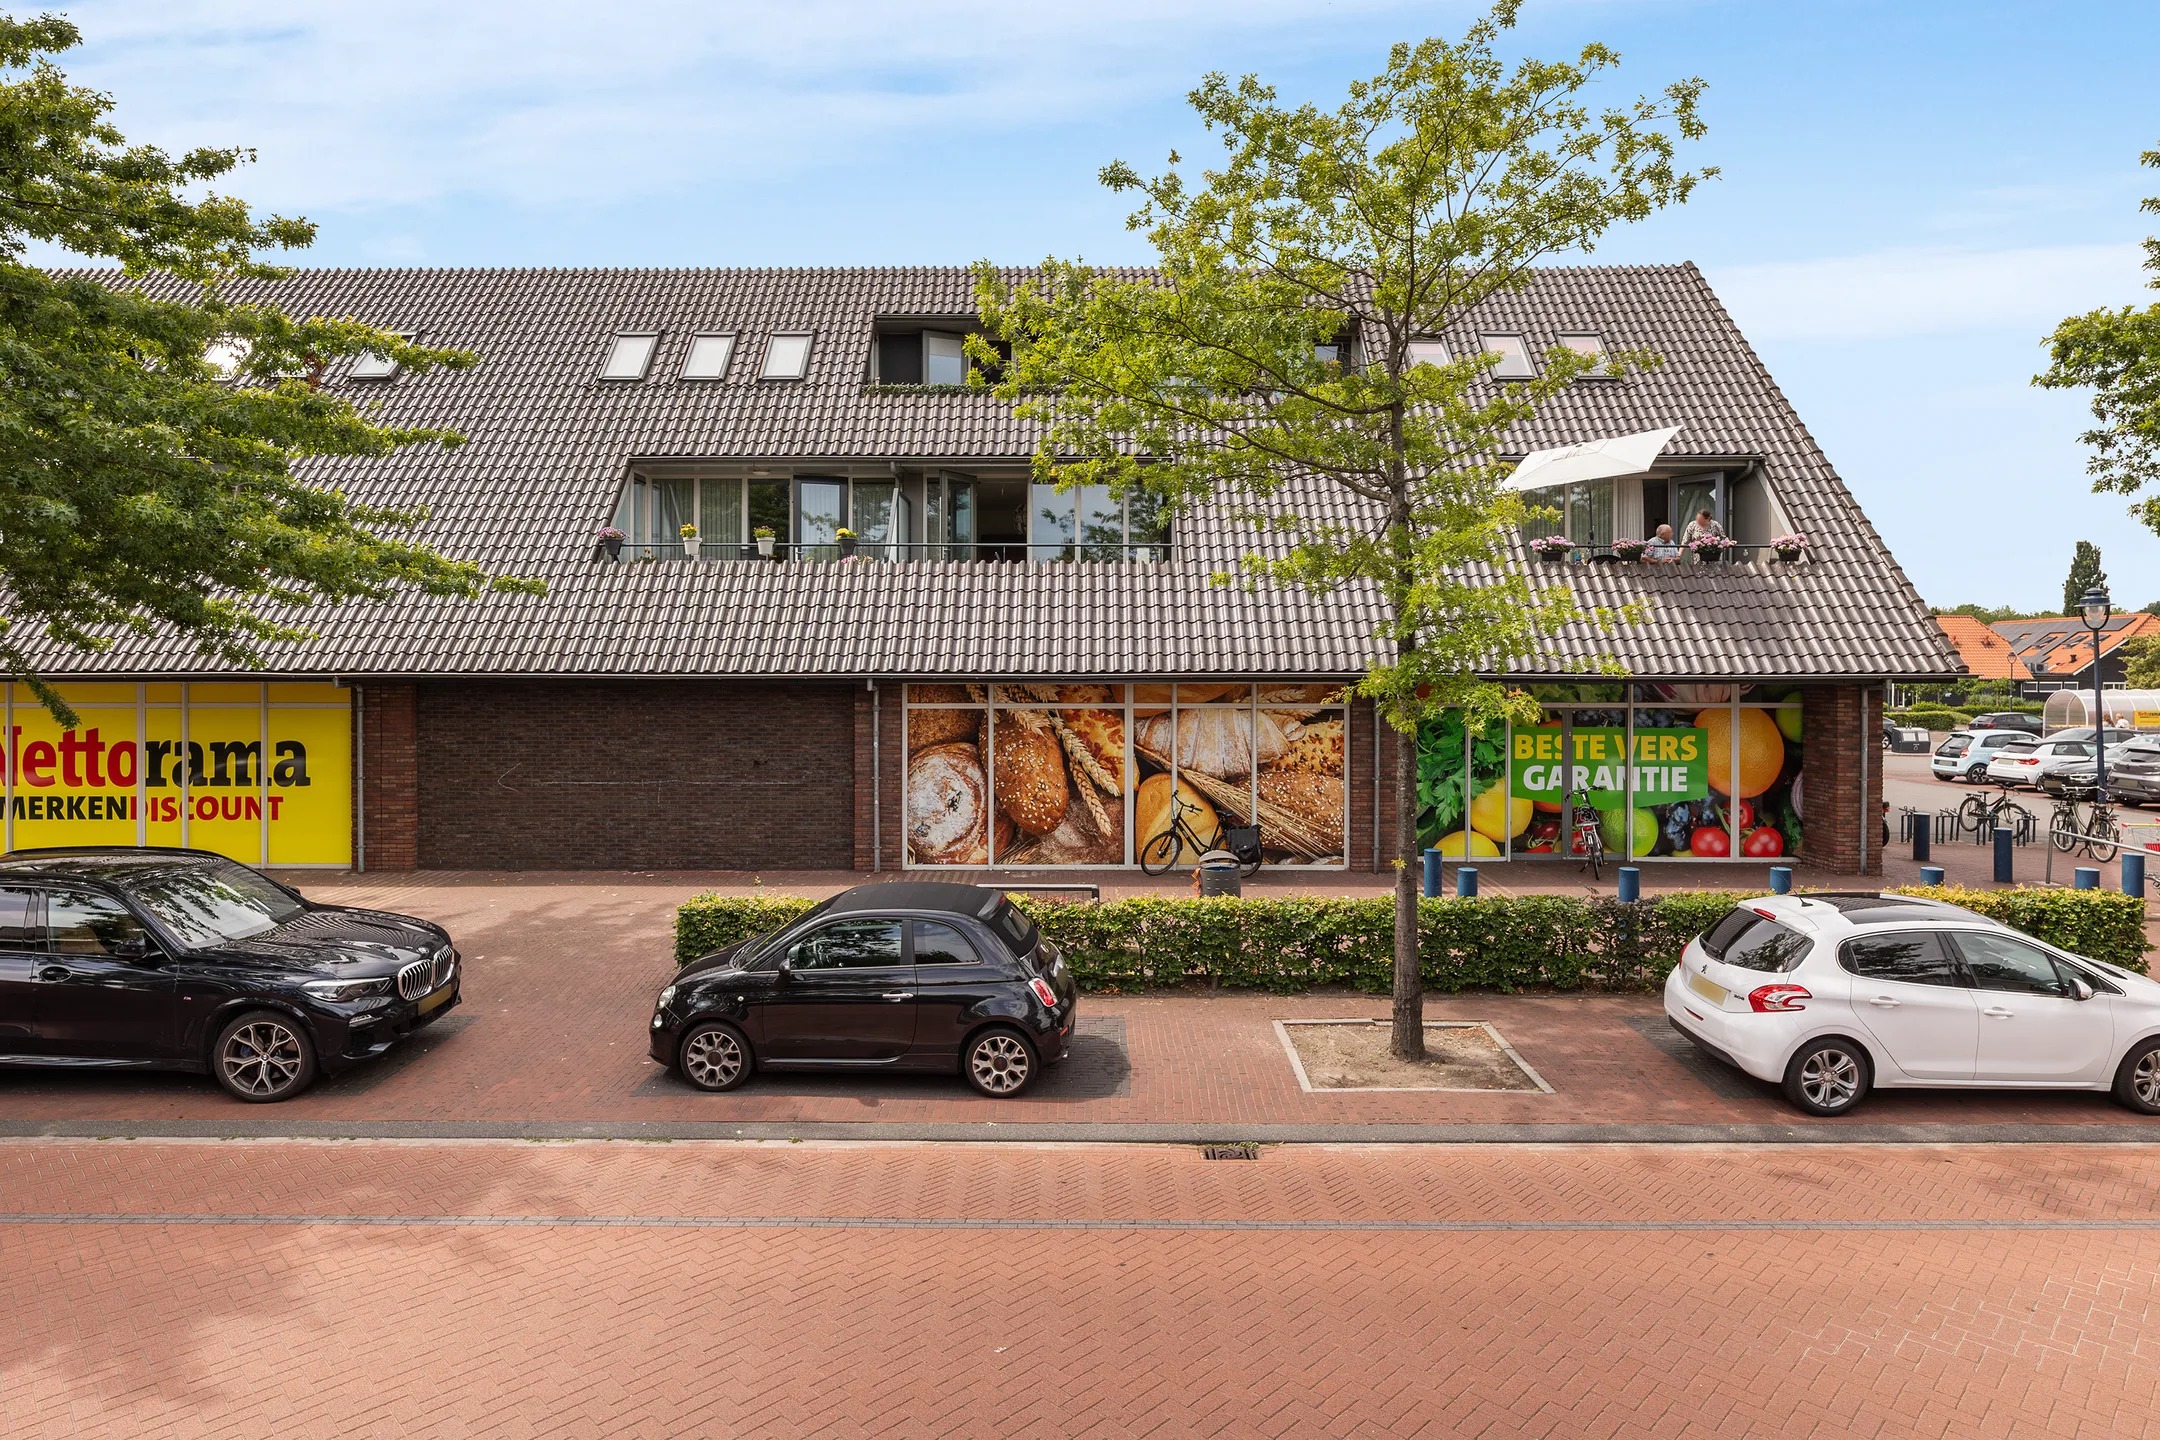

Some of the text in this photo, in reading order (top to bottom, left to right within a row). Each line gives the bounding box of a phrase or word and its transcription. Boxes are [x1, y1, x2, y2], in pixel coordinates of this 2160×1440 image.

[1514, 734, 1698, 761] BESTE VERS
[1523, 765, 1688, 792] GARANTIE
